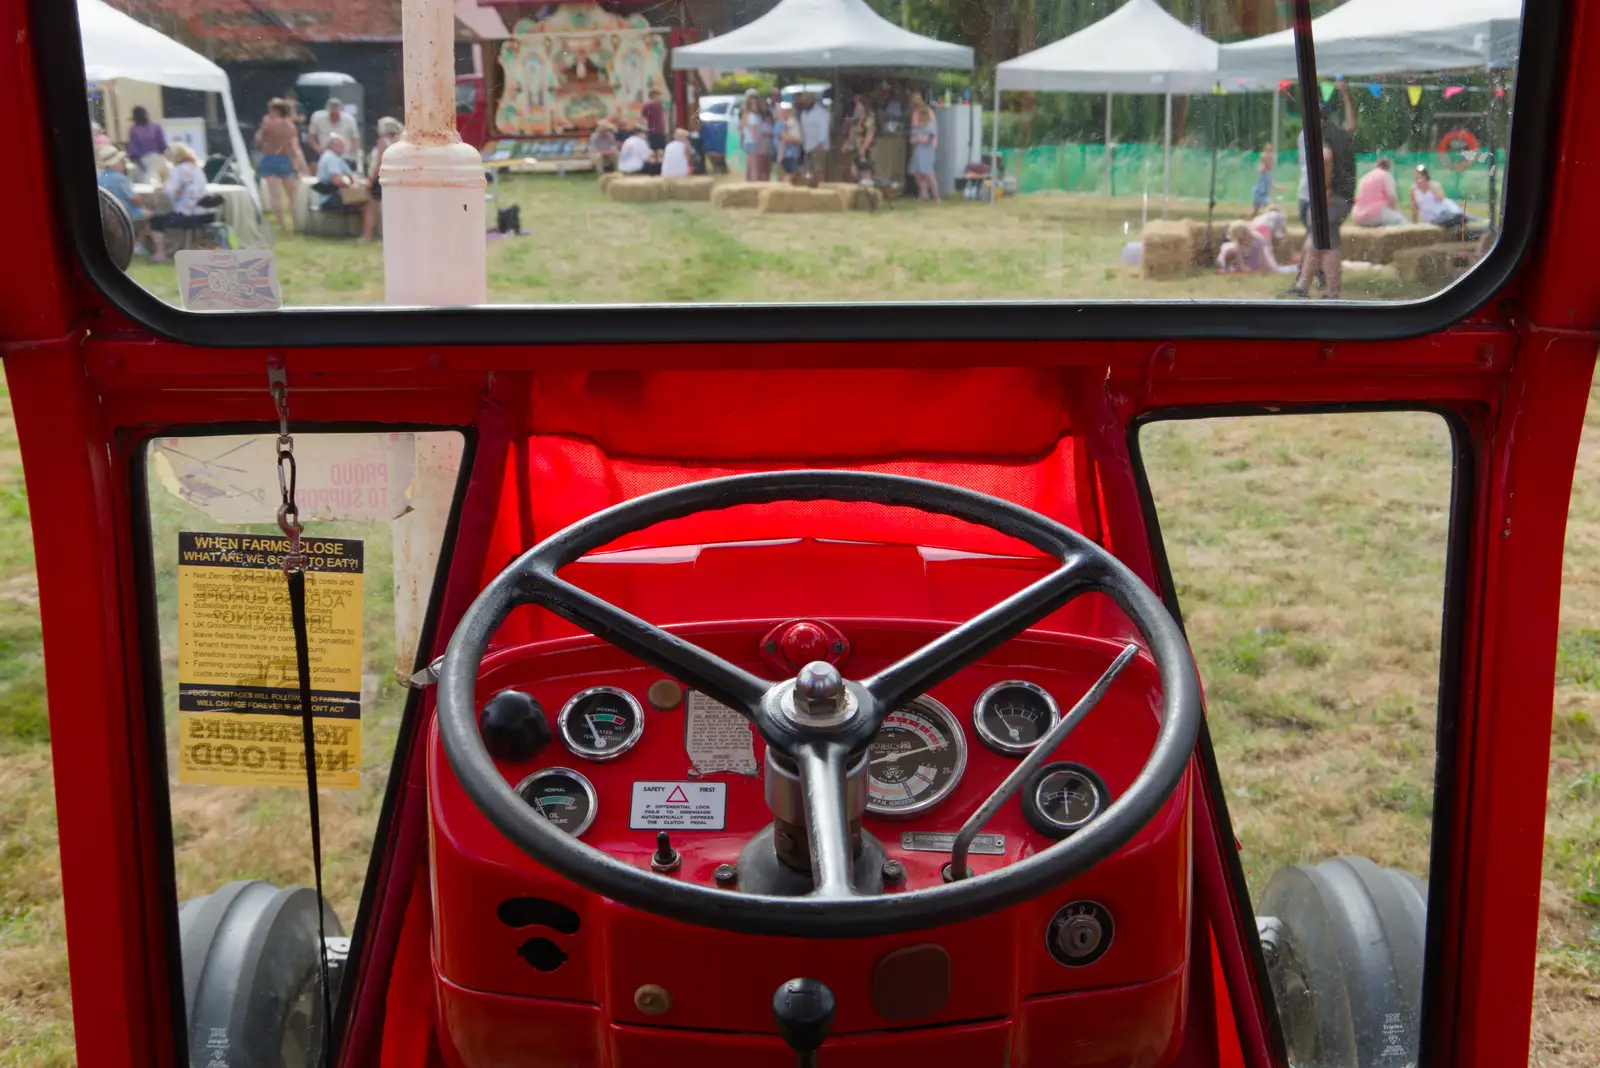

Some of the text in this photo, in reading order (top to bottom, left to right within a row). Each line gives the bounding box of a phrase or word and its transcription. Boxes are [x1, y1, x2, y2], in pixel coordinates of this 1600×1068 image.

[194, 536, 344, 555] WHEN FARMS CLOSE
[183, 551, 216, 562] WHAT
[219, 552, 244, 564] ARE
[246, 554, 265, 565] WE
[308, 556, 324, 567] TO
[326, 557, 358, 569] EAT?!
[208, 572, 225, 580] Zero
[319, 578, 337, 586] costs
[323, 587, 352, 598] phasing
[192, 601, 229, 610] Subsidies
[244, 604, 265, 614] being
[192, 621, 205, 629] UK
[207, 621, 252, 631] Government
[253, 624, 278, 633] paying
[236, 633, 257, 641] fallow
[193, 640, 219, 649] Tenant
[220, 642, 249, 650] farmers
[193, 660, 223, 670] Farming
[313, 666, 351, 675] production
[209, 690, 253, 699] SHORTAGES
[254, 692, 271, 700] WILL
[196, 699, 214, 708] WILL
[215, 700, 248, 709] CHANGE
[248, 701, 284, 710] FOREVER
[329, 705, 345, 713] ACT
